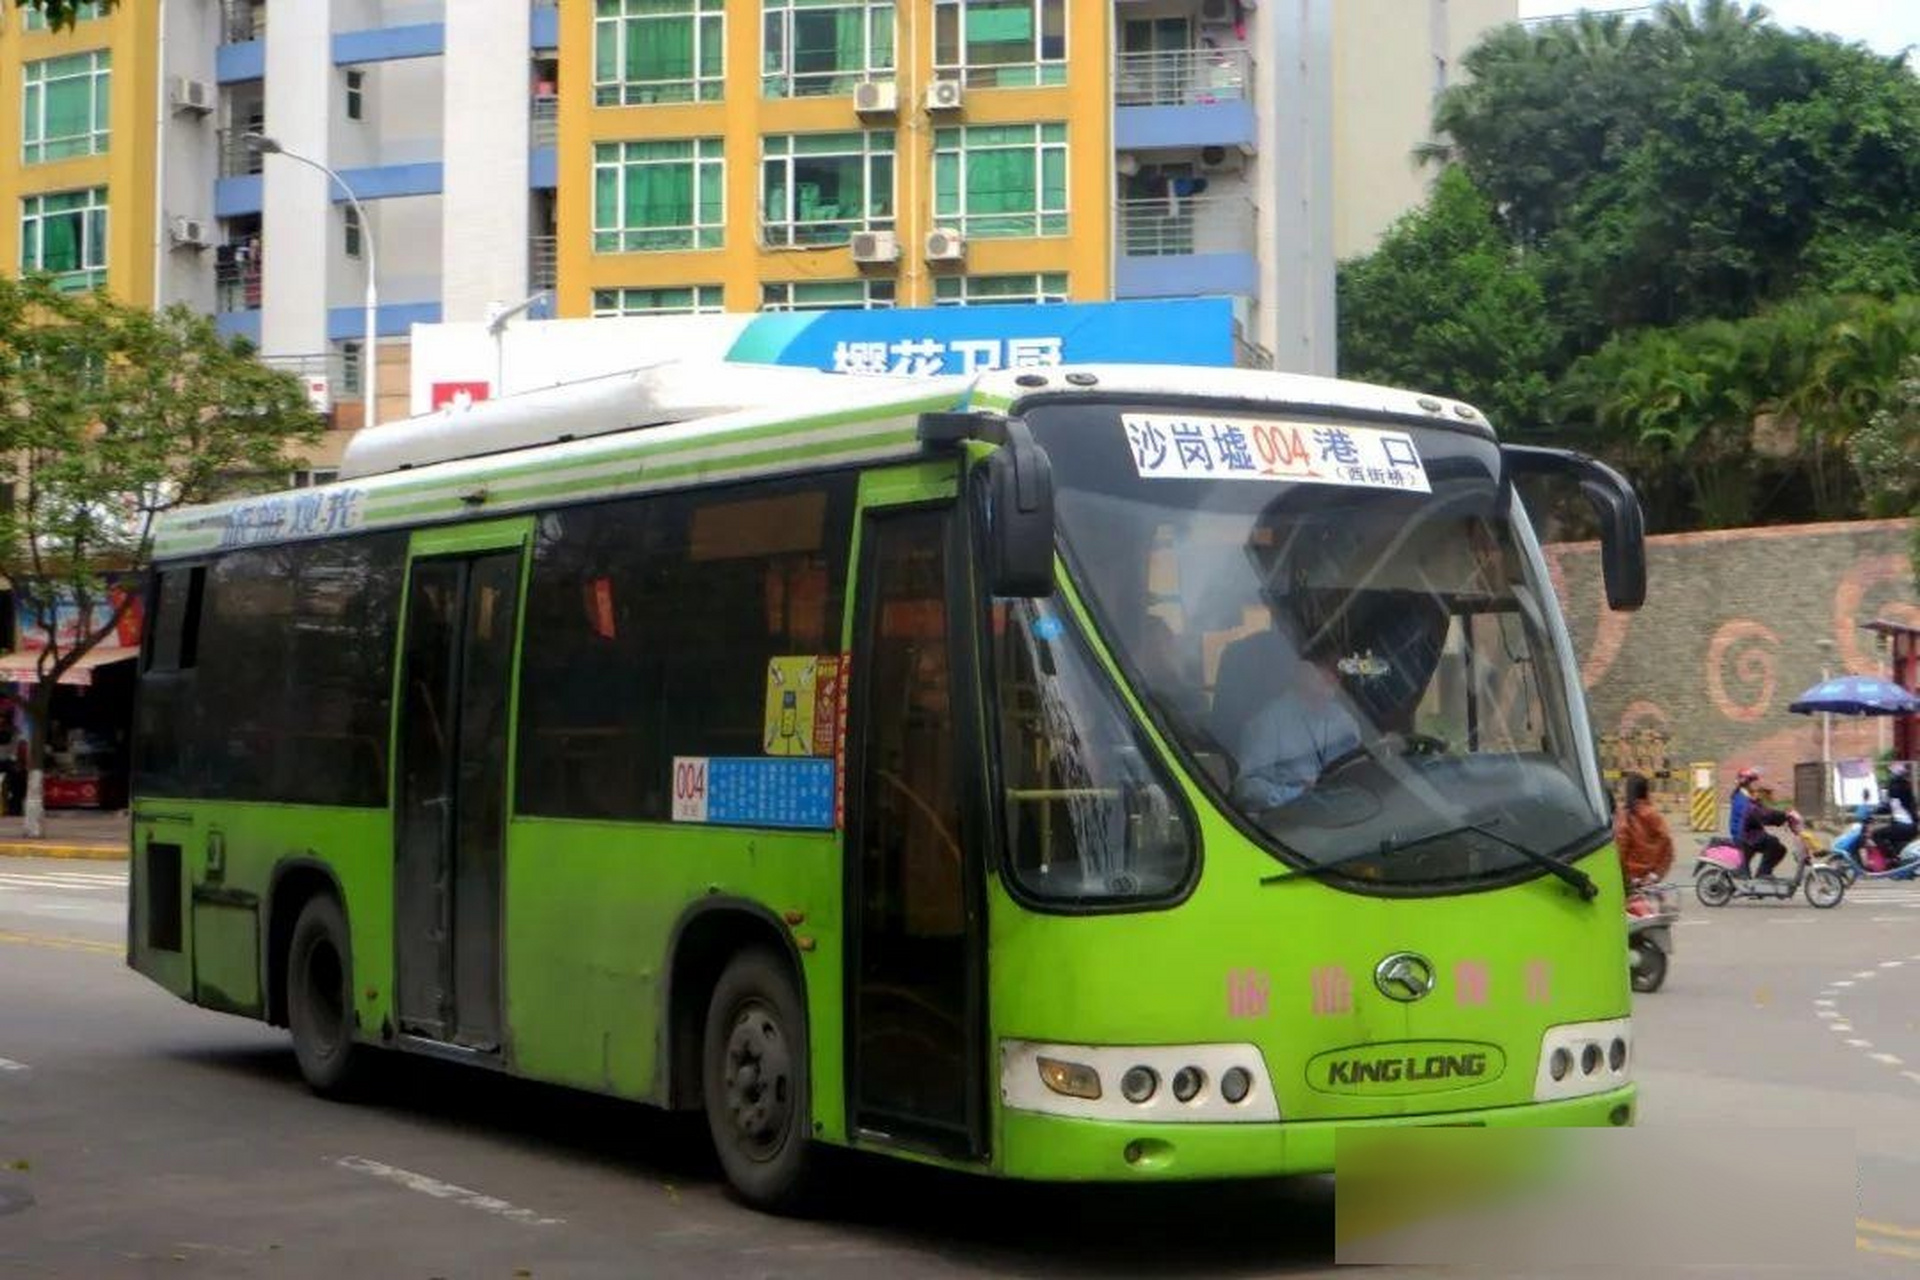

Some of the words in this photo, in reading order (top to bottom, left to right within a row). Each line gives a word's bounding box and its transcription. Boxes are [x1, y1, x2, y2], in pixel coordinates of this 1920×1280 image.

[834, 337, 1062, 376] 樱花卫厨
[1129, 422, 1255, 470] 沙岗墟
[1252, 425, 1309, 466] 004
[1313, 428, 1420, 469] 港口
[676, 763, 705, 799] 004
